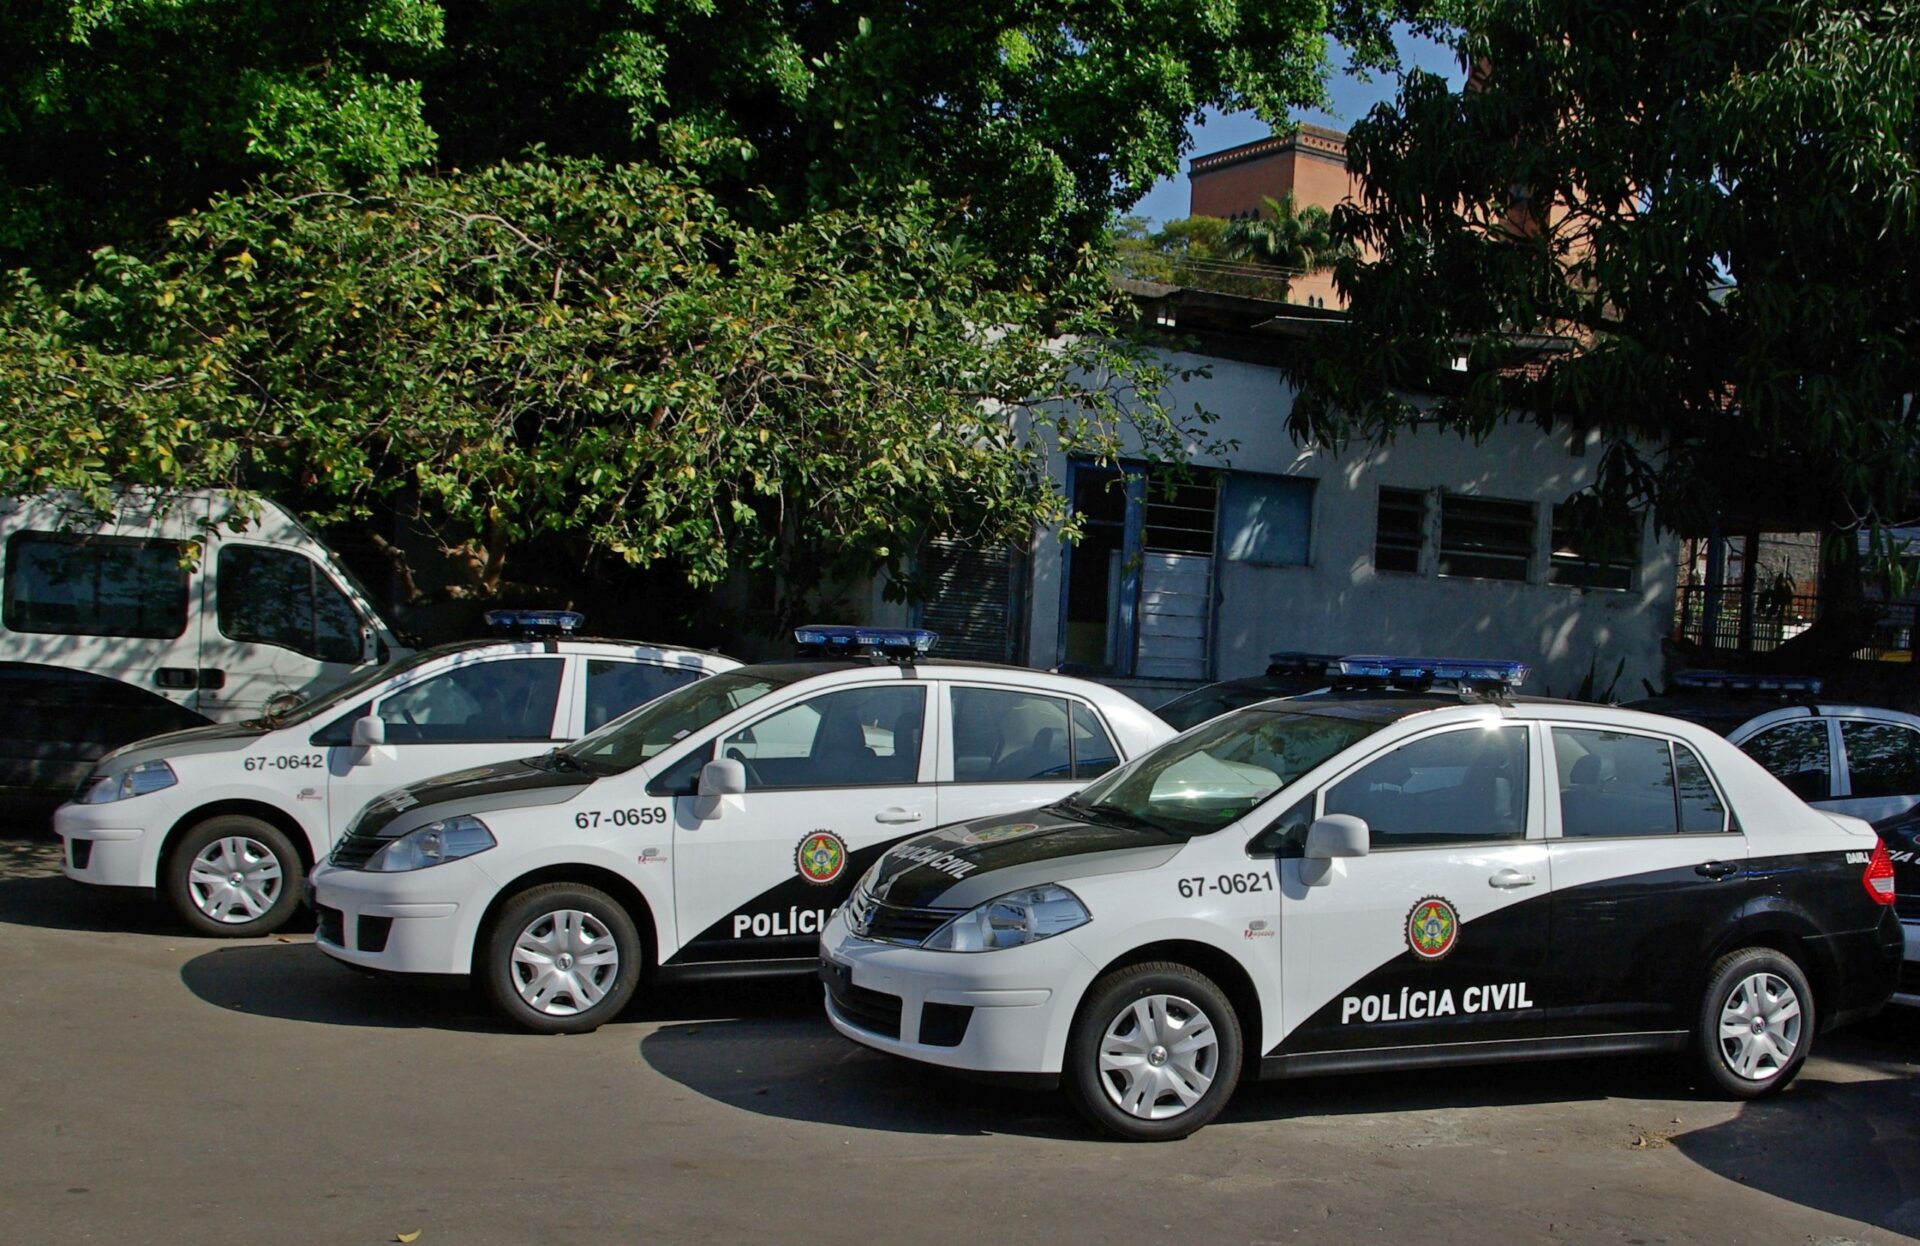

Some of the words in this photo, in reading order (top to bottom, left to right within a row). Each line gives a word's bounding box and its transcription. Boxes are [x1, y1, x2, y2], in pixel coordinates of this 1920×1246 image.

[244, 754, 324, 771] 67-0642
[575, 807, 667, 829] 67-0659
[929, 854, 978, 880] CIVIL
[1178, 871, 1273, 898] 67-0621
[734, 906, 838, 938] POLÍCI
[1341, 986, 1456, 1024] POLÍCIA
[1463, 982, 1533, 1013] CIVIL
